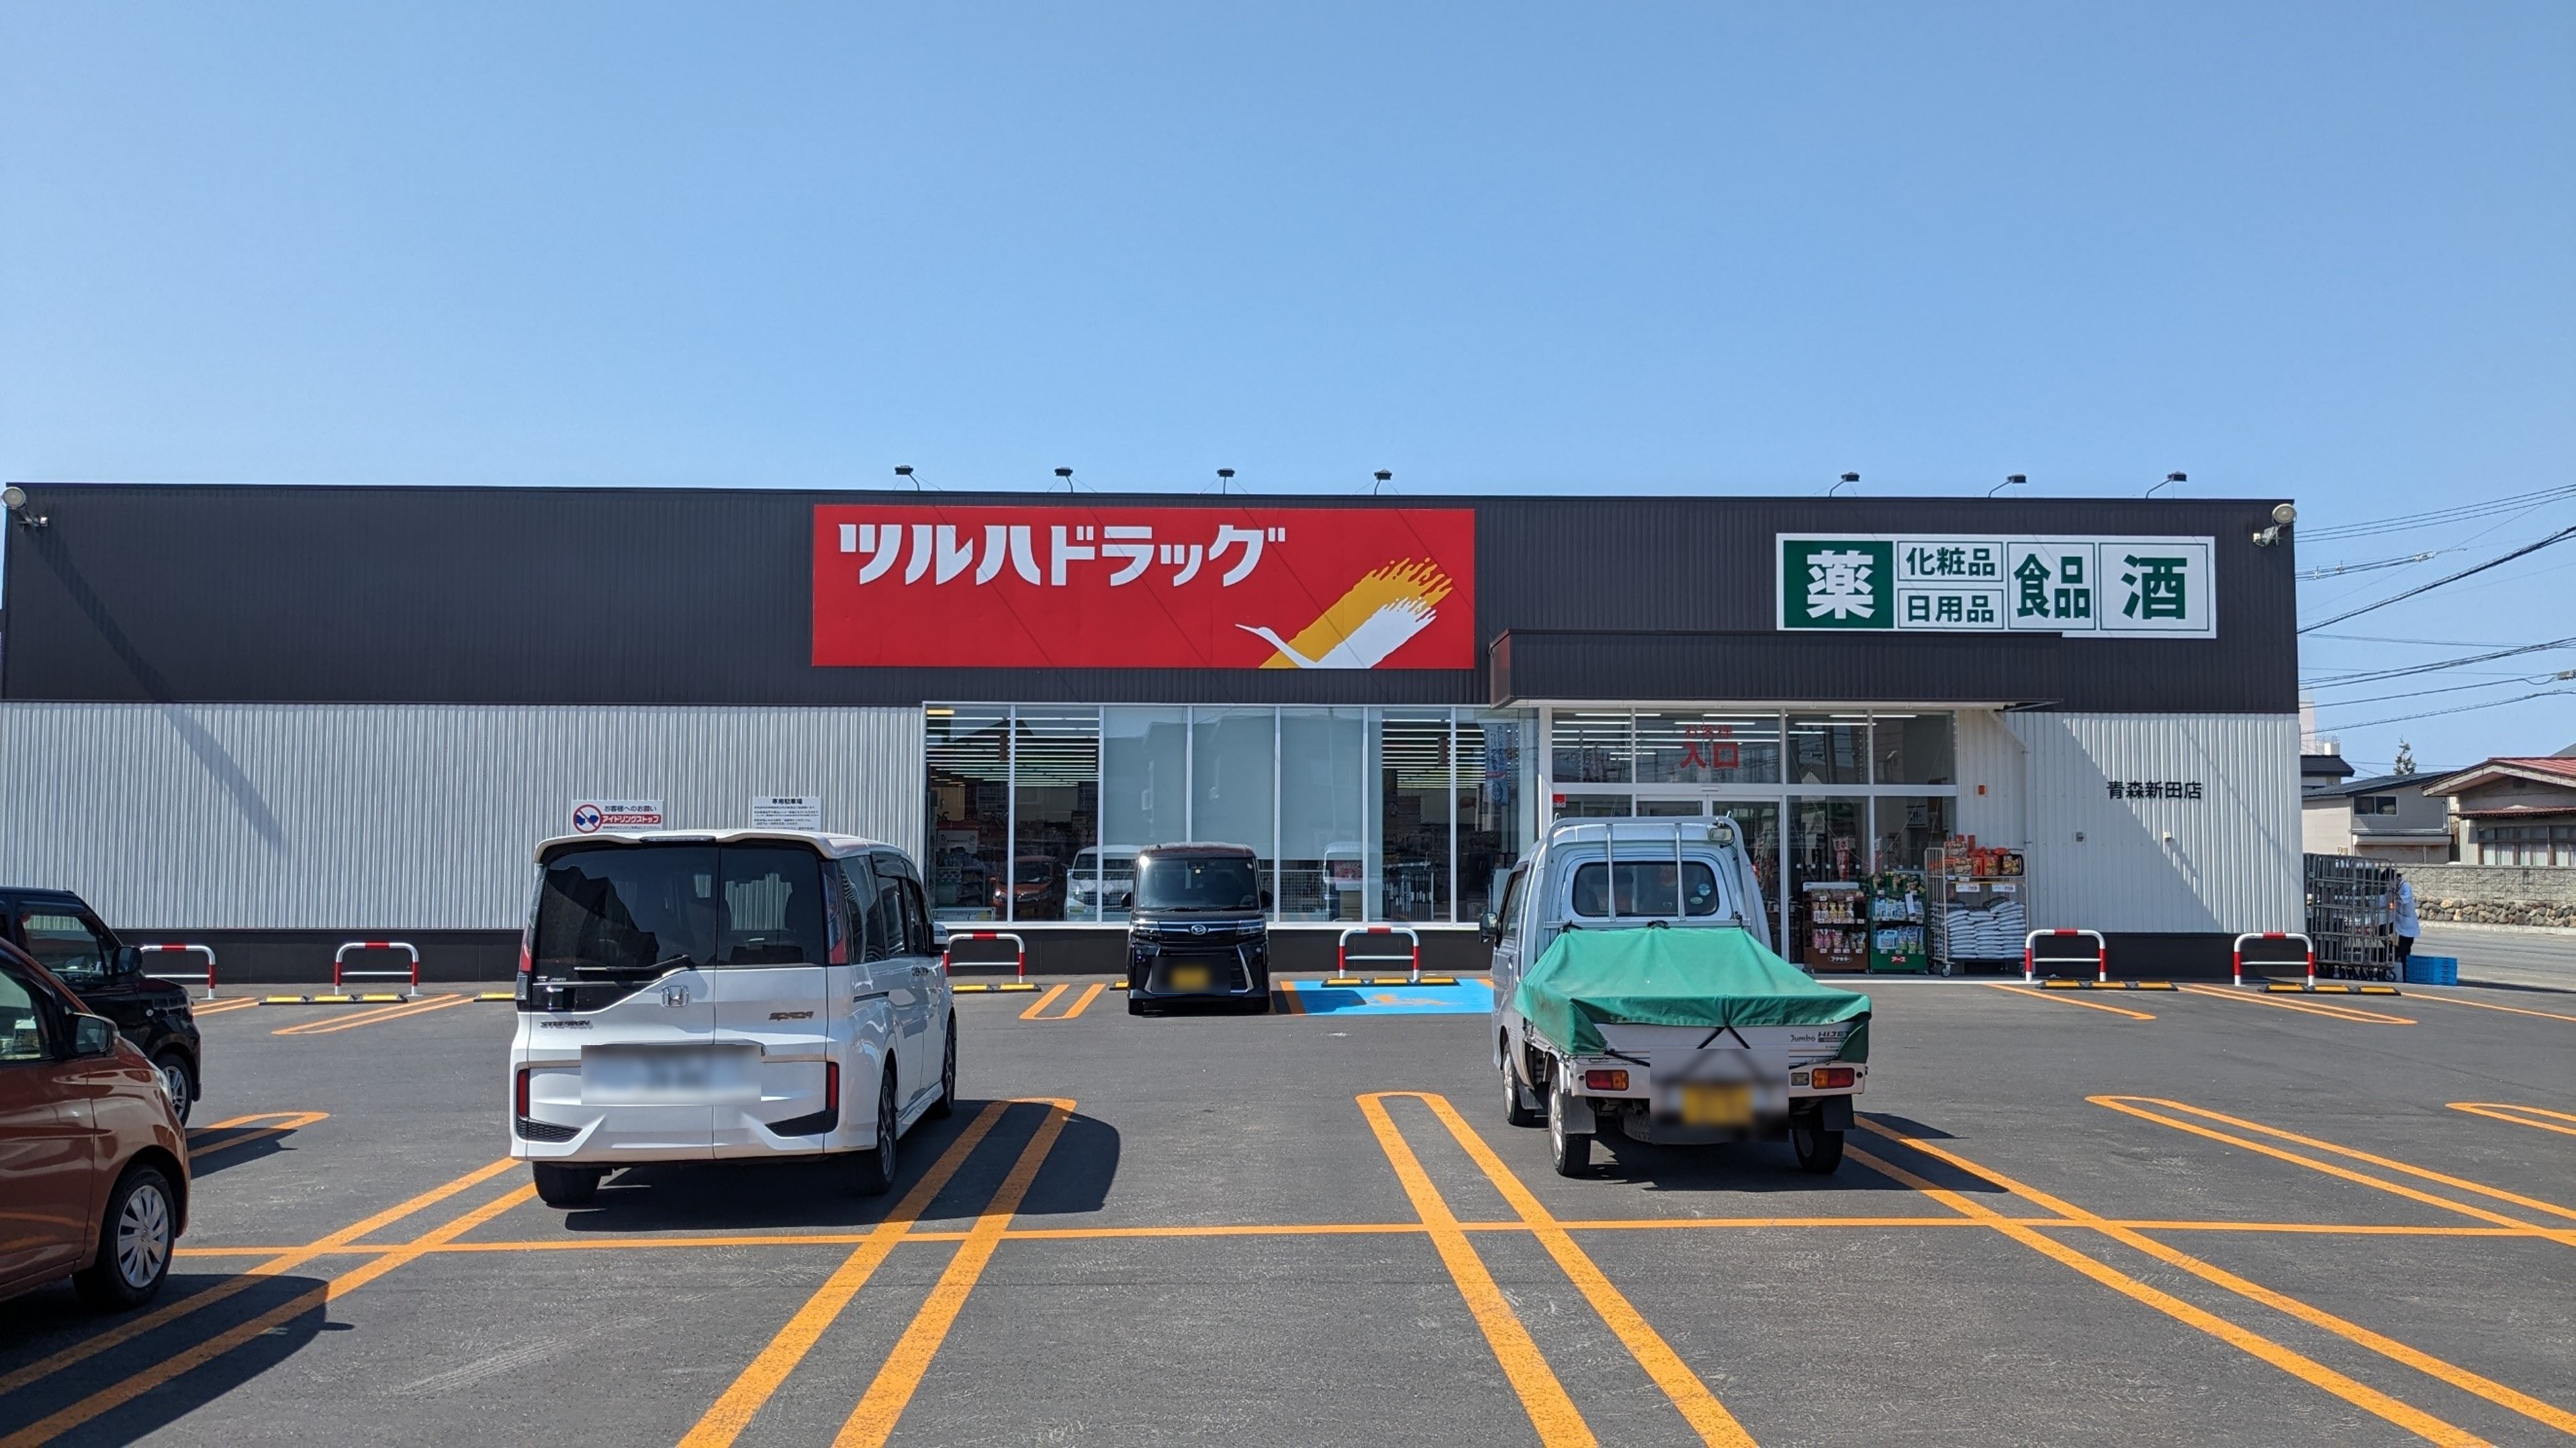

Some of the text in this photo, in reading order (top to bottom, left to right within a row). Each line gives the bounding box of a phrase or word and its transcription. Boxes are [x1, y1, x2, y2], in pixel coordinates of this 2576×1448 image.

[838, 523, 1286, 587] ツルハドラッグ
[1905, 547, 1996, 576] 化粧品
[1806, 549, 1875, 620] 薬
[2013, 553, 2091, 620] 食品
[2121, 554, 2188, 620] 酒
[1907, 594, 1994, 623] 日用品
[1685, 725, 1732, 739] お客様
[1680, 742, 1739, 768] 入口
[2106, 780, 2202, 800] 青森新田店
